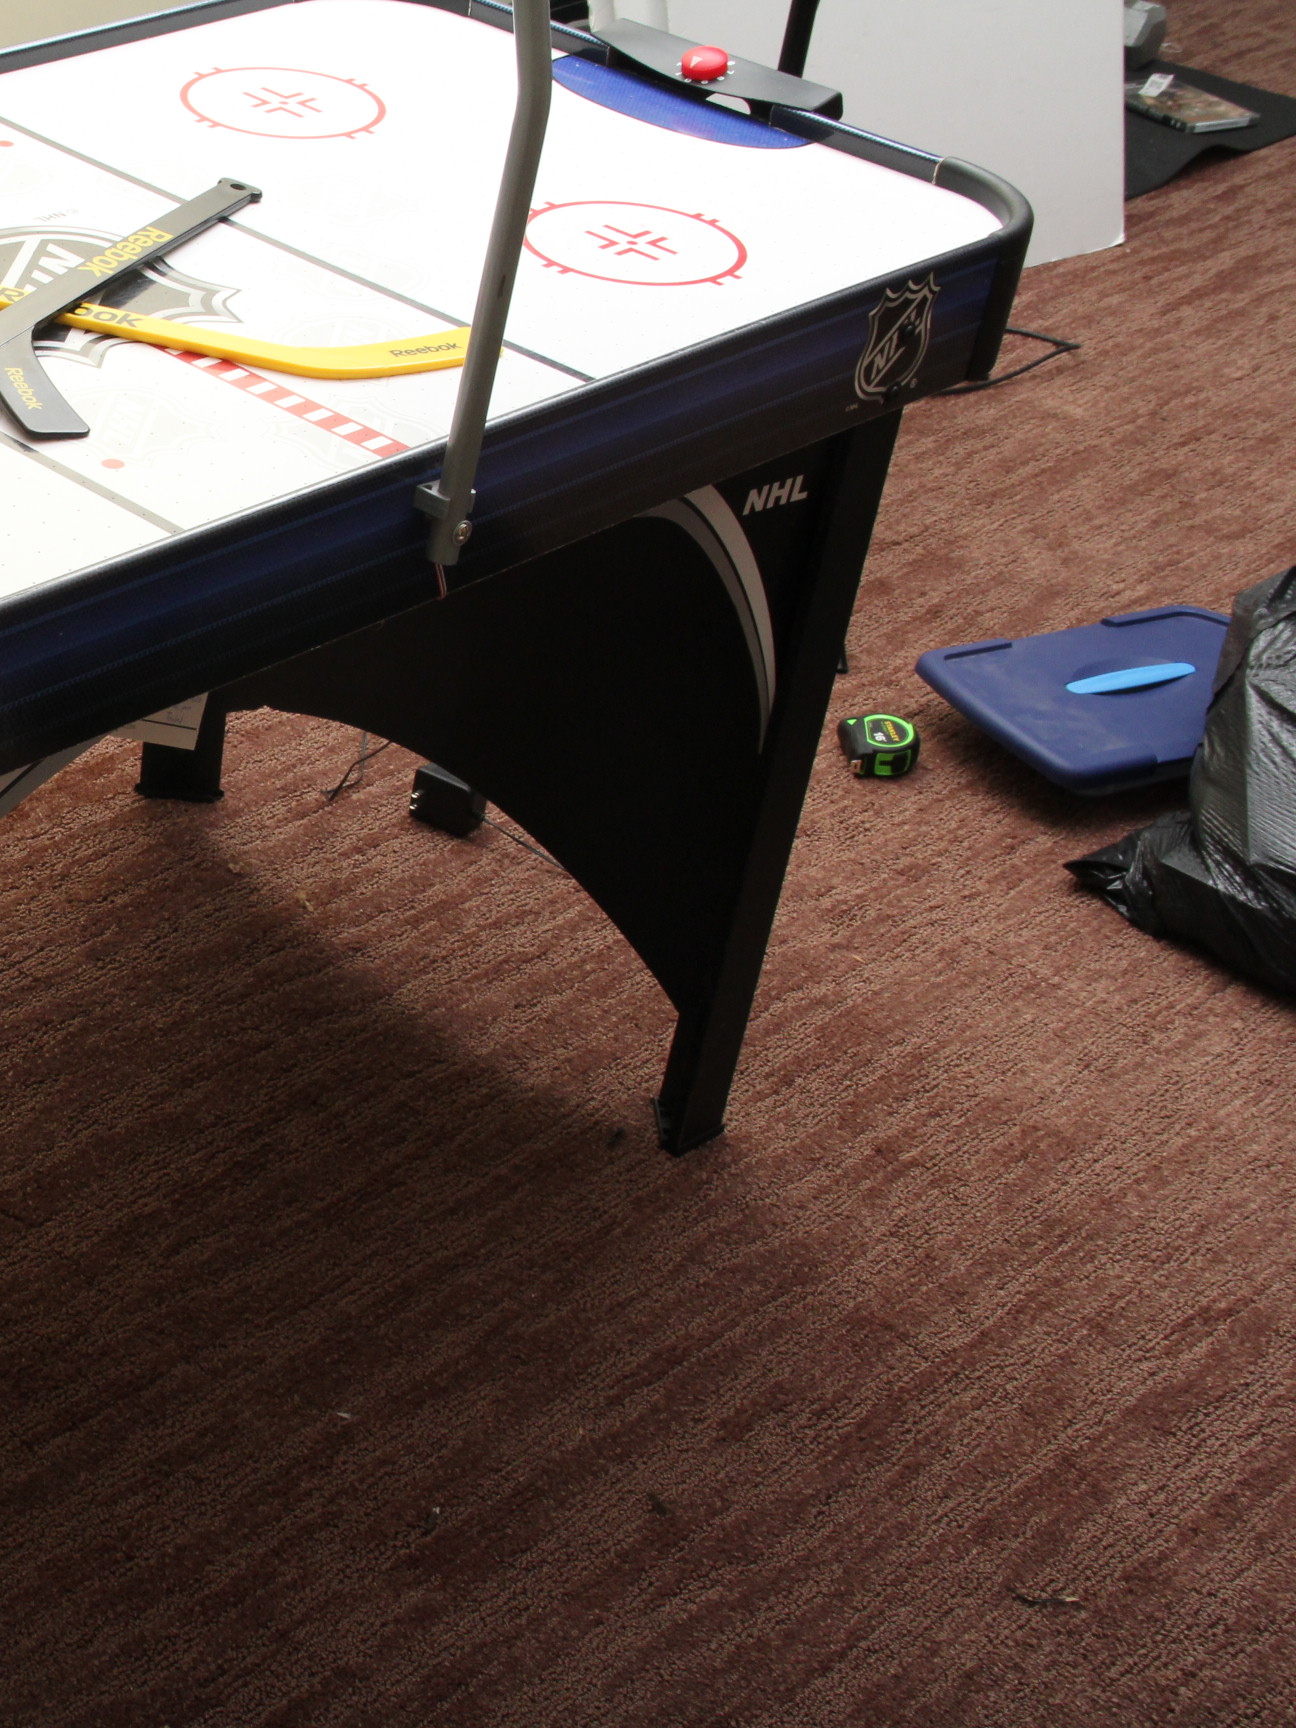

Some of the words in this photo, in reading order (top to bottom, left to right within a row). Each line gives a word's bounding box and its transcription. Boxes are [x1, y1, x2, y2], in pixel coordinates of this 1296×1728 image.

[77, 226, 174, 277] Reebok
[389, 342, 461, 357] Reebok
[4, 367, 43, 410] Reebok
[742, 475, 808, 516] NHL
